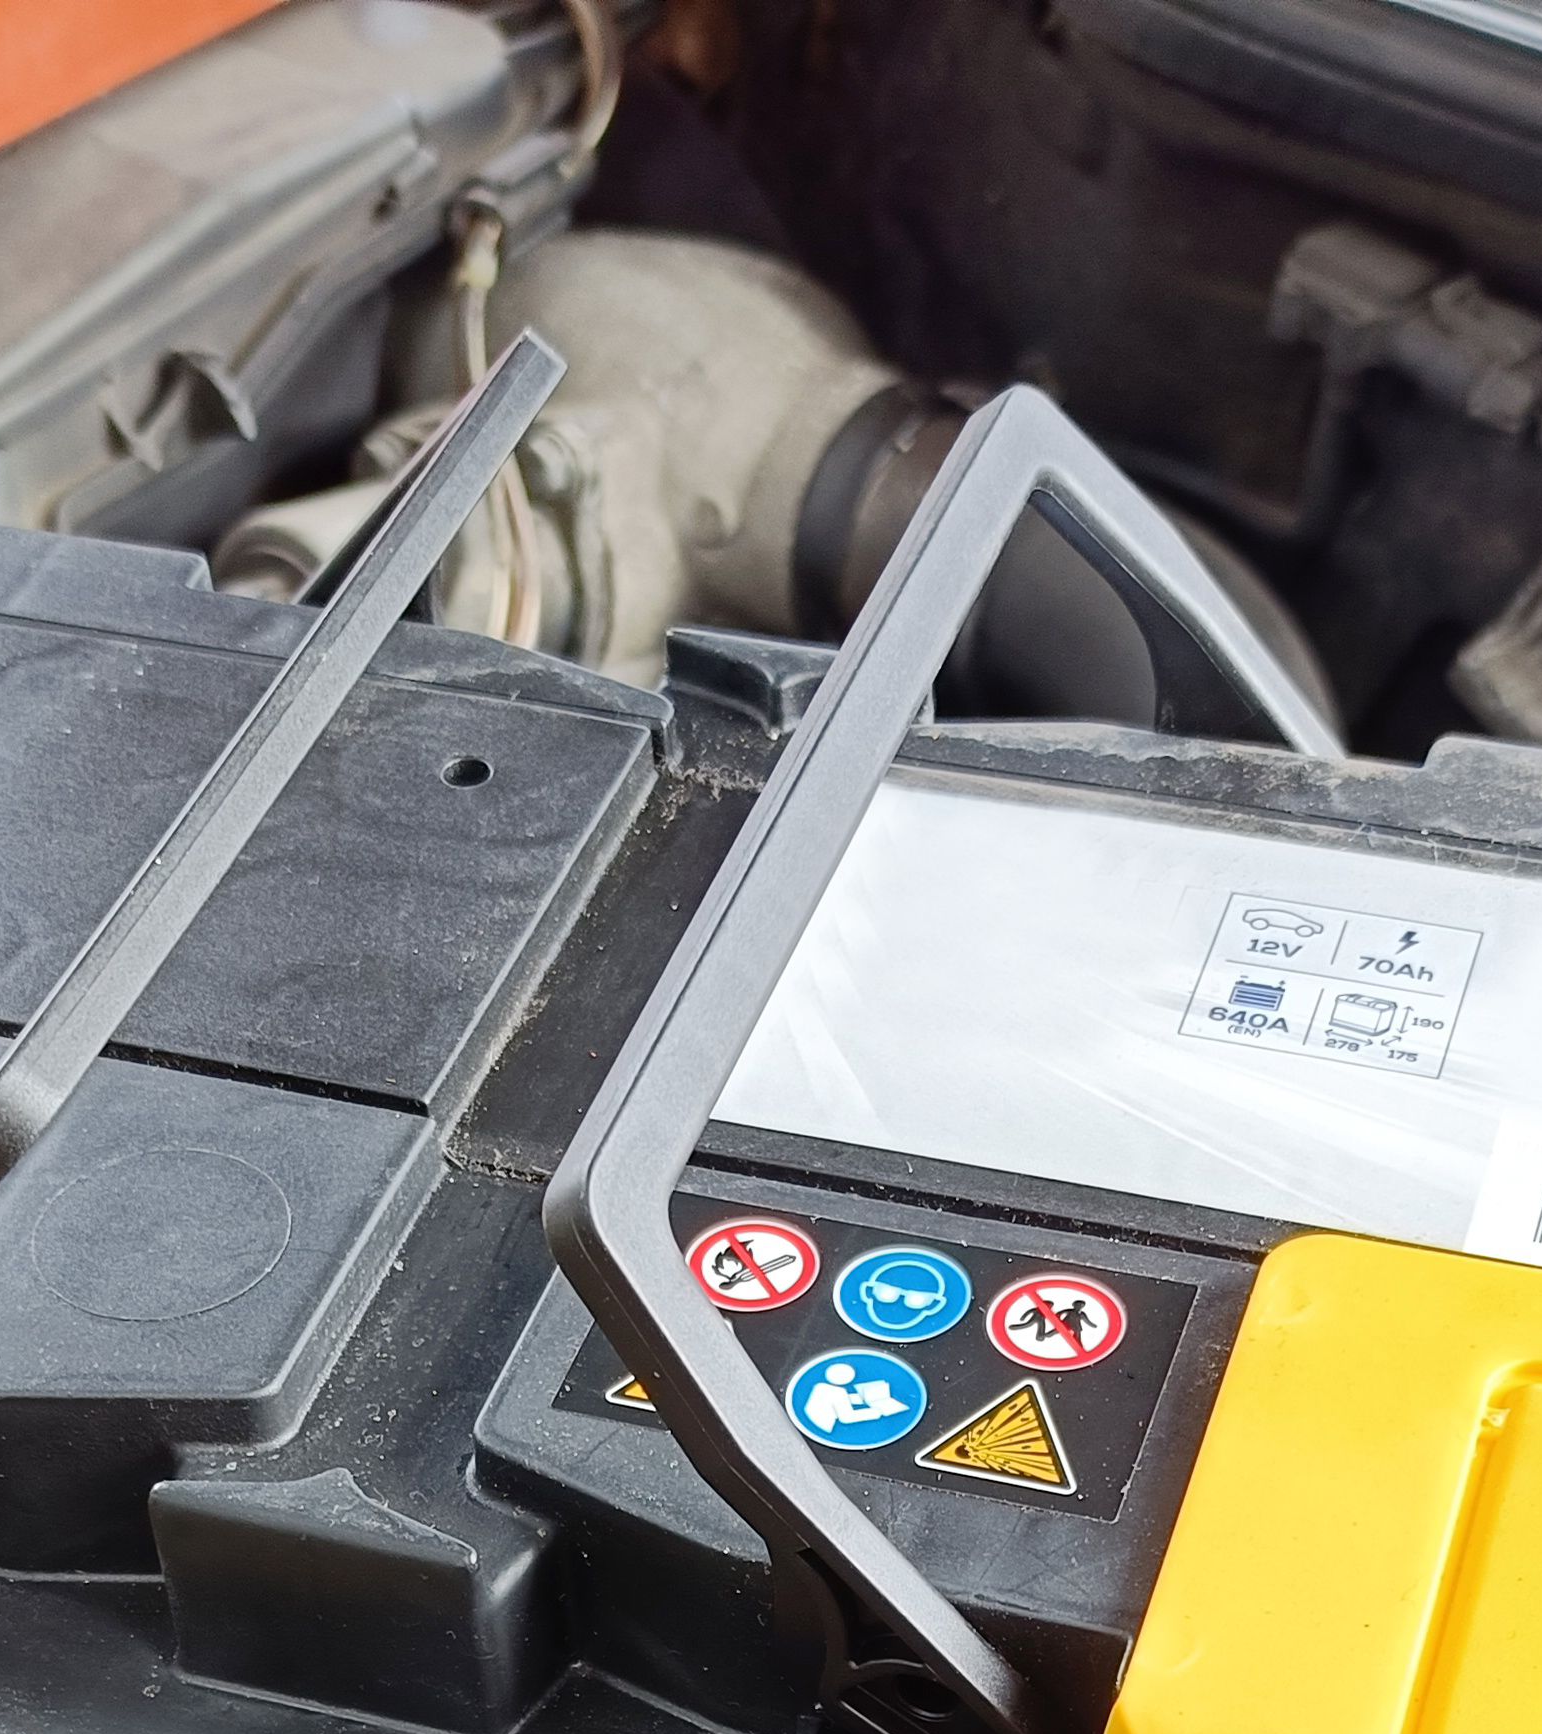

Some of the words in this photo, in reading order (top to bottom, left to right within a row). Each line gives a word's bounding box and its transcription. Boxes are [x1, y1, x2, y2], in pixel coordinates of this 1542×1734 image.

[1246, 938, 1303, 958] 12V
[1358, 956, 1435, 982] 70Ah
[1208, 1006, 1290, 1033] 640A
[1411, 1016, 1445, 1031] 190
[1227, 1024, 1262, 1039] (EN)
[1324, 1038, 1360, 1052] 278
[1387, 1049, 1418, 1063] 175
